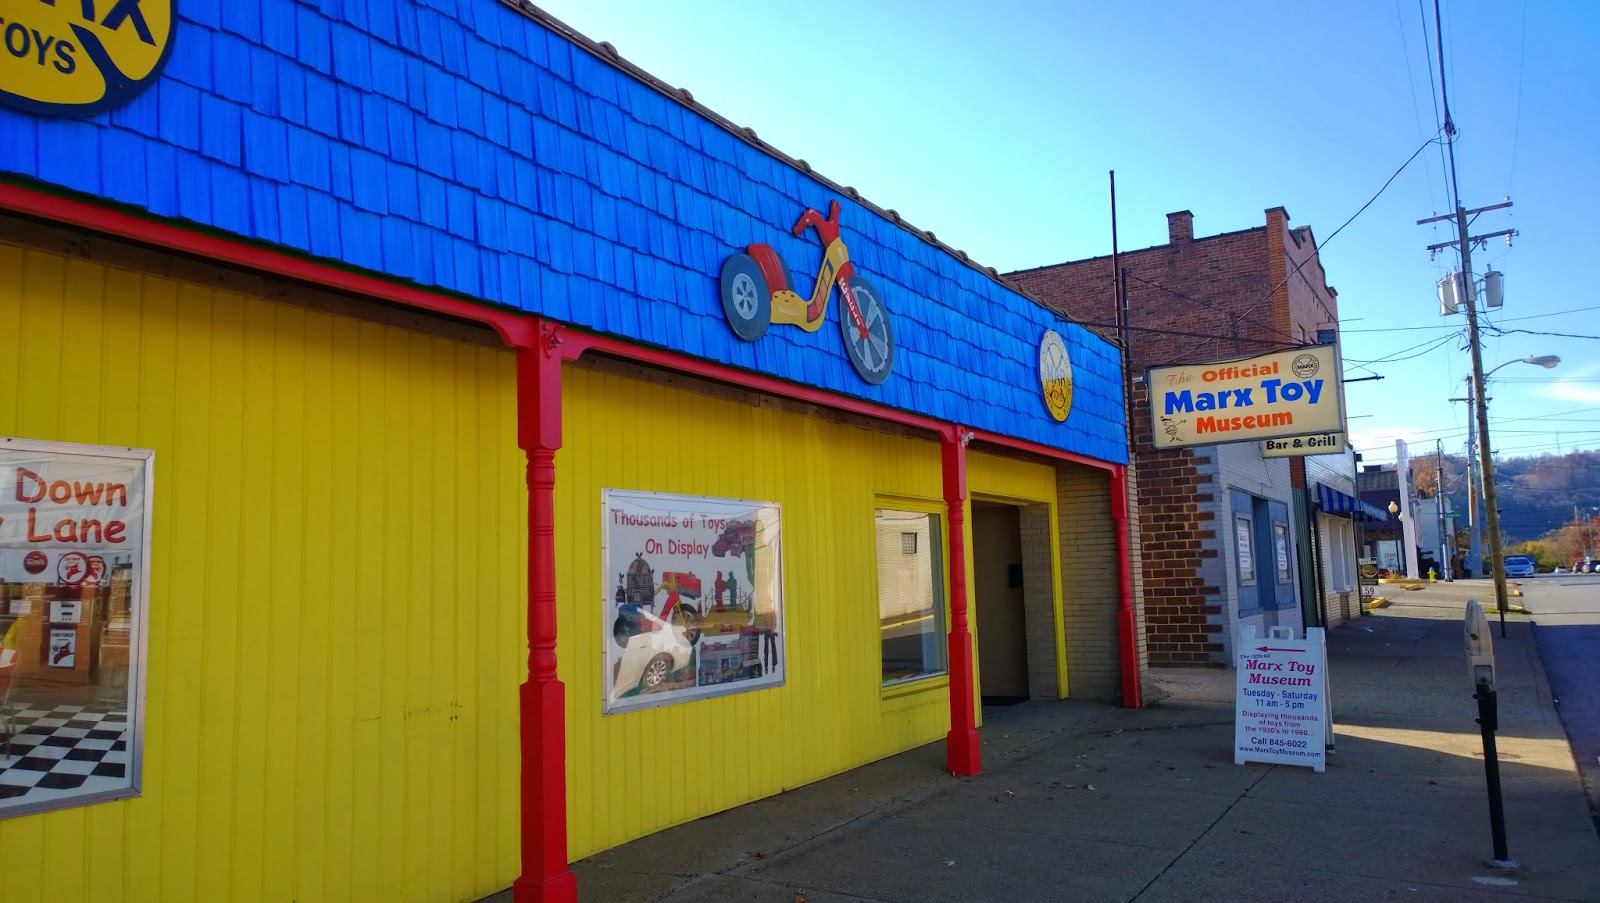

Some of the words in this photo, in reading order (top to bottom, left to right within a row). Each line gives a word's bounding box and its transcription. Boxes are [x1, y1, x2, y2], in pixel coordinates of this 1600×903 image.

[0, 18, 76, 75] OYS
[1166, 371, 1192, 386] The
[1201, 361, 1279, 383] Official
[1164, 386, 1253, 415] Marx
[1260, 379, 1324, 404] Toy
[1196, 411, 1293, 434] Museum
[1266, 440, 1288, 450] Bar
[1292, 439, 1303, 448] &
[1307, 435, 1336, 447] Grill
[15, 466, 127, 507] Down
[27, 507, 127, 544] Lane
[610, 508, 677, 528] Thousands
[682, 512, 695, 529] of
[700, 513, 726, 534] Toys
[645, 538, 663, 554] On
[668, 538, 709, 559] Display
[1245, 659, 1283, 671] Marx
[1287, 661, 1315, 675] Toy
[1248, 673, 1312, 686] Museum
[1243, 687, 1275, 699] Tuesday
[1281, 690, 1318, 702] Saturday
[1255, 698, 1264, 706] 11
[1266, 700, 1279, 708] am
[1285, 700, 1290, 708] 5
[1292, 701, 1305, 710] pm
[1242, 710, 1279, 720] Displaying
[1280, 713, 1318, 721] thousands
[1251, 736, 1267, 745] Call
[1269, 738, 1307, 748] 845-6022
[1238, 745, 1321, 758] www.MarxToyMuseum.com
